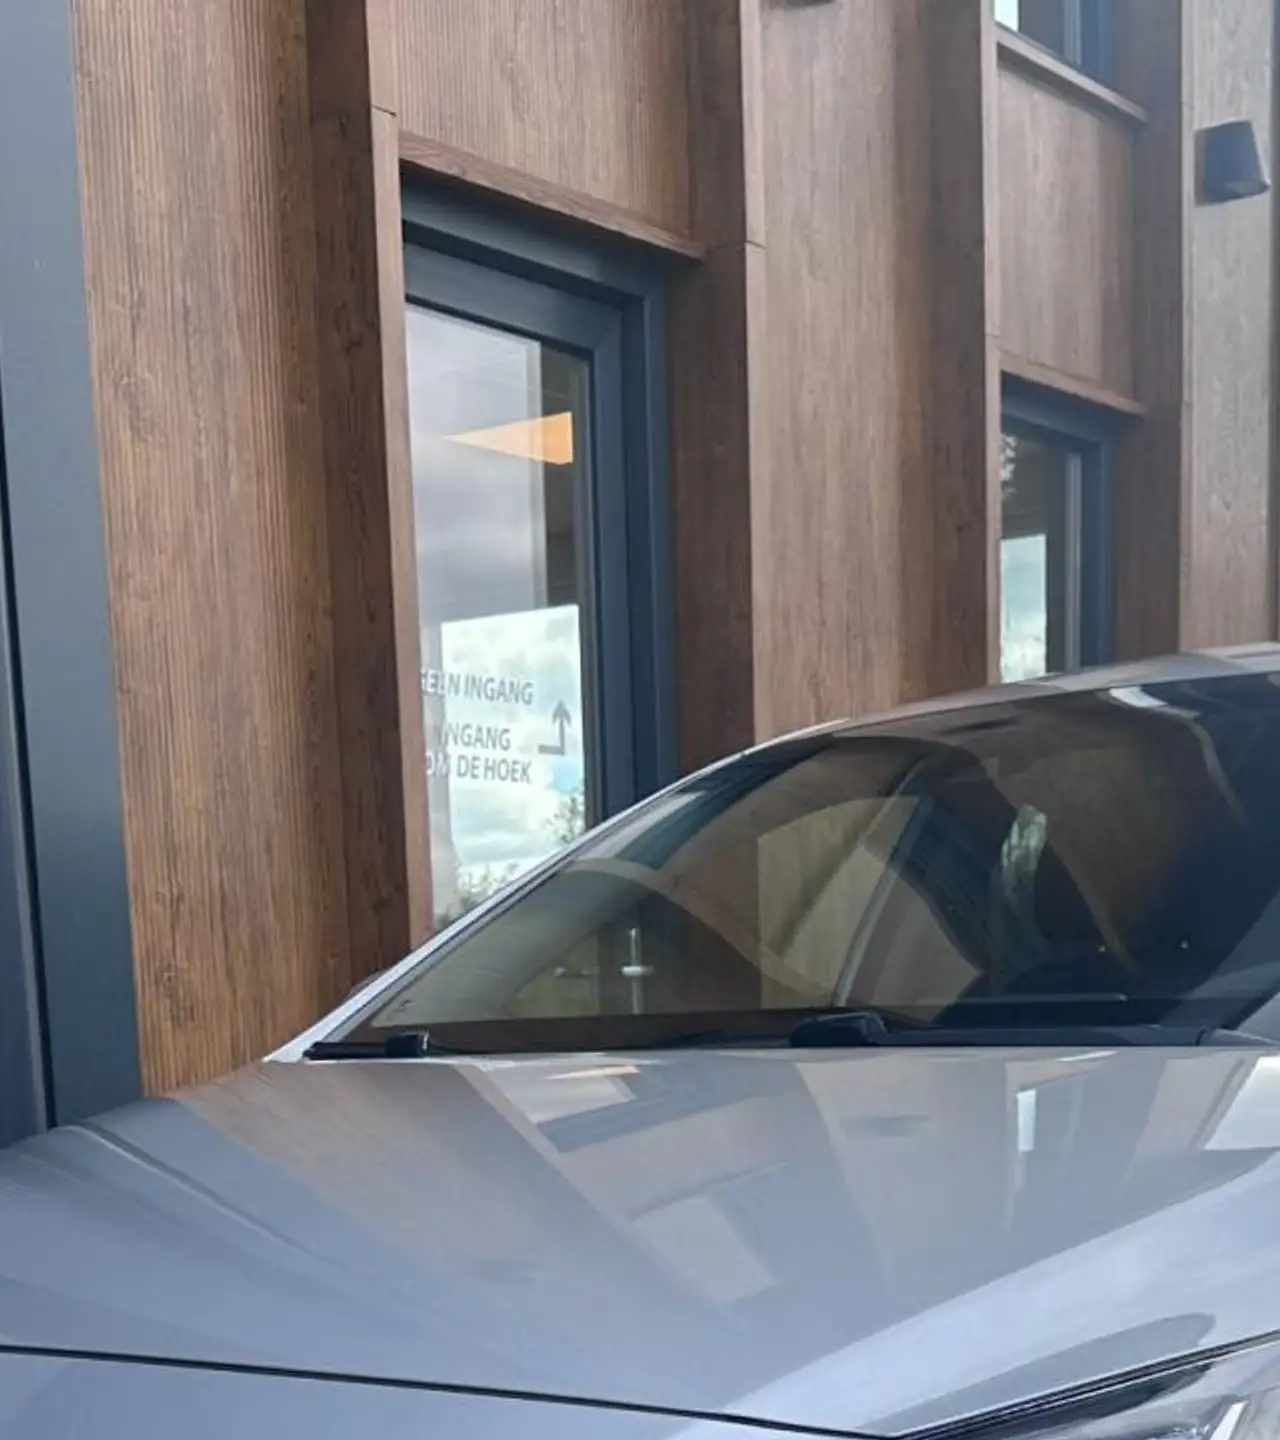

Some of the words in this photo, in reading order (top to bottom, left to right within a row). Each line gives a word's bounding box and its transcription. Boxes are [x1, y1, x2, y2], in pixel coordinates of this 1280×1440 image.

[463, 673, 534, 706] INGANG
[455, 754, 481, 780] DE
[483, 757, 532, 785] HOEK
